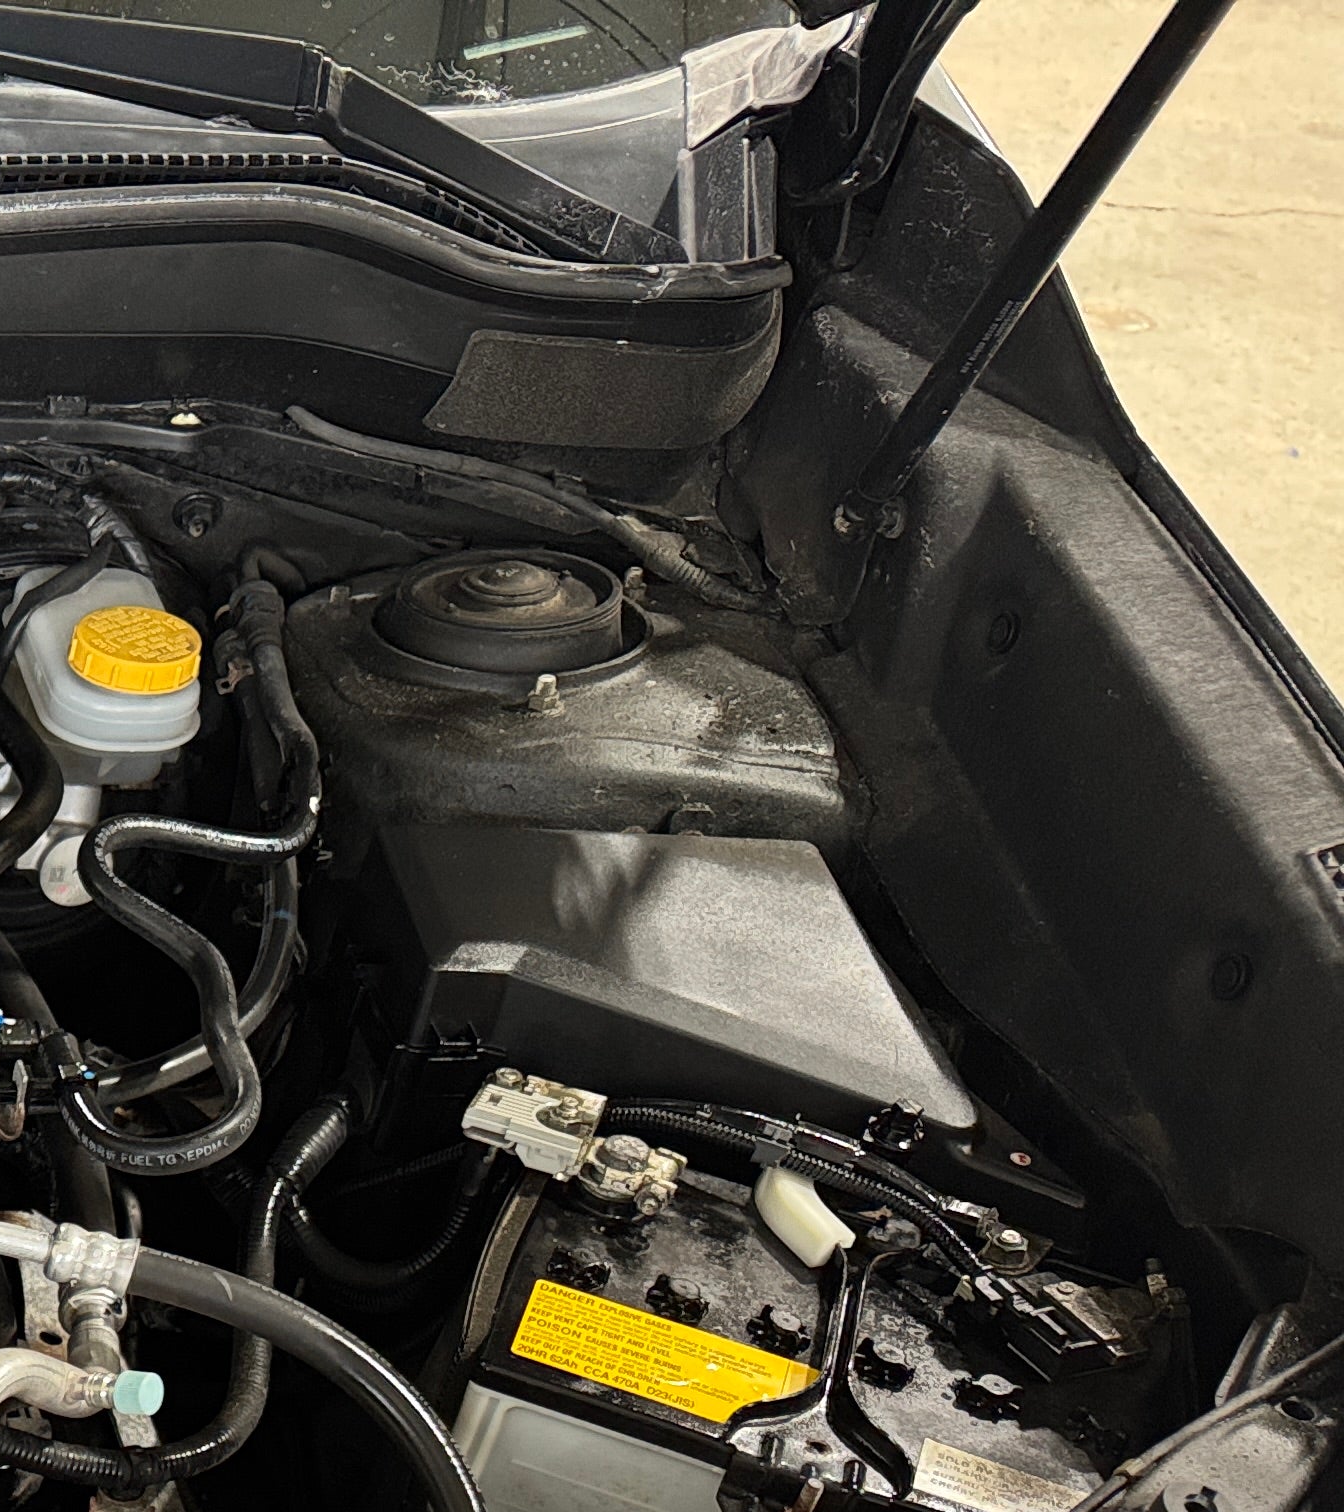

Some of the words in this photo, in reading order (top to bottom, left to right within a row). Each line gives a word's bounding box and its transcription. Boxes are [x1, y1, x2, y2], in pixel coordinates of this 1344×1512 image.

[121, 1153, 153, 1166] FUEL
[539, 1282, 595, 1306] DANGER
[598, 1302, 642, 1322] EXPLOSIVE
[644, 1318, 671, 1331] GASES
[526, 1315, 582, 1338] POISON
[585, 1335, 617, 1351] CAUSES
[620, 1346, 649, 1362] SEVERE
[530, 1306, 552, 1317] KEEP
[553, 1313, 575, 1325] VENT
[575, 1321, 598, 1333] CAPS
[600, 1328, 625, 1342] TIGHT
[626, 1338, 644, 1348] AND
[645, 1343, 670, 1358] LEVEL
[516, 1343, 547, 1359] 20HR
[582, 1365, 609, 1380] CCA
[611, 1375, 639, 1390] 470A
[645, 1385, 695, 1408] D23(JIS)
[519, 1334, 541, 1345] KEEP
[542, 1341, 561, 1352] OUT
[561, 1347, 573, 1355] OF
[574, 1352, 603, 1366] REACH
[604, 1362, 616, 1370] OF
[617, 1366, 660, 1386] CHILDREN
